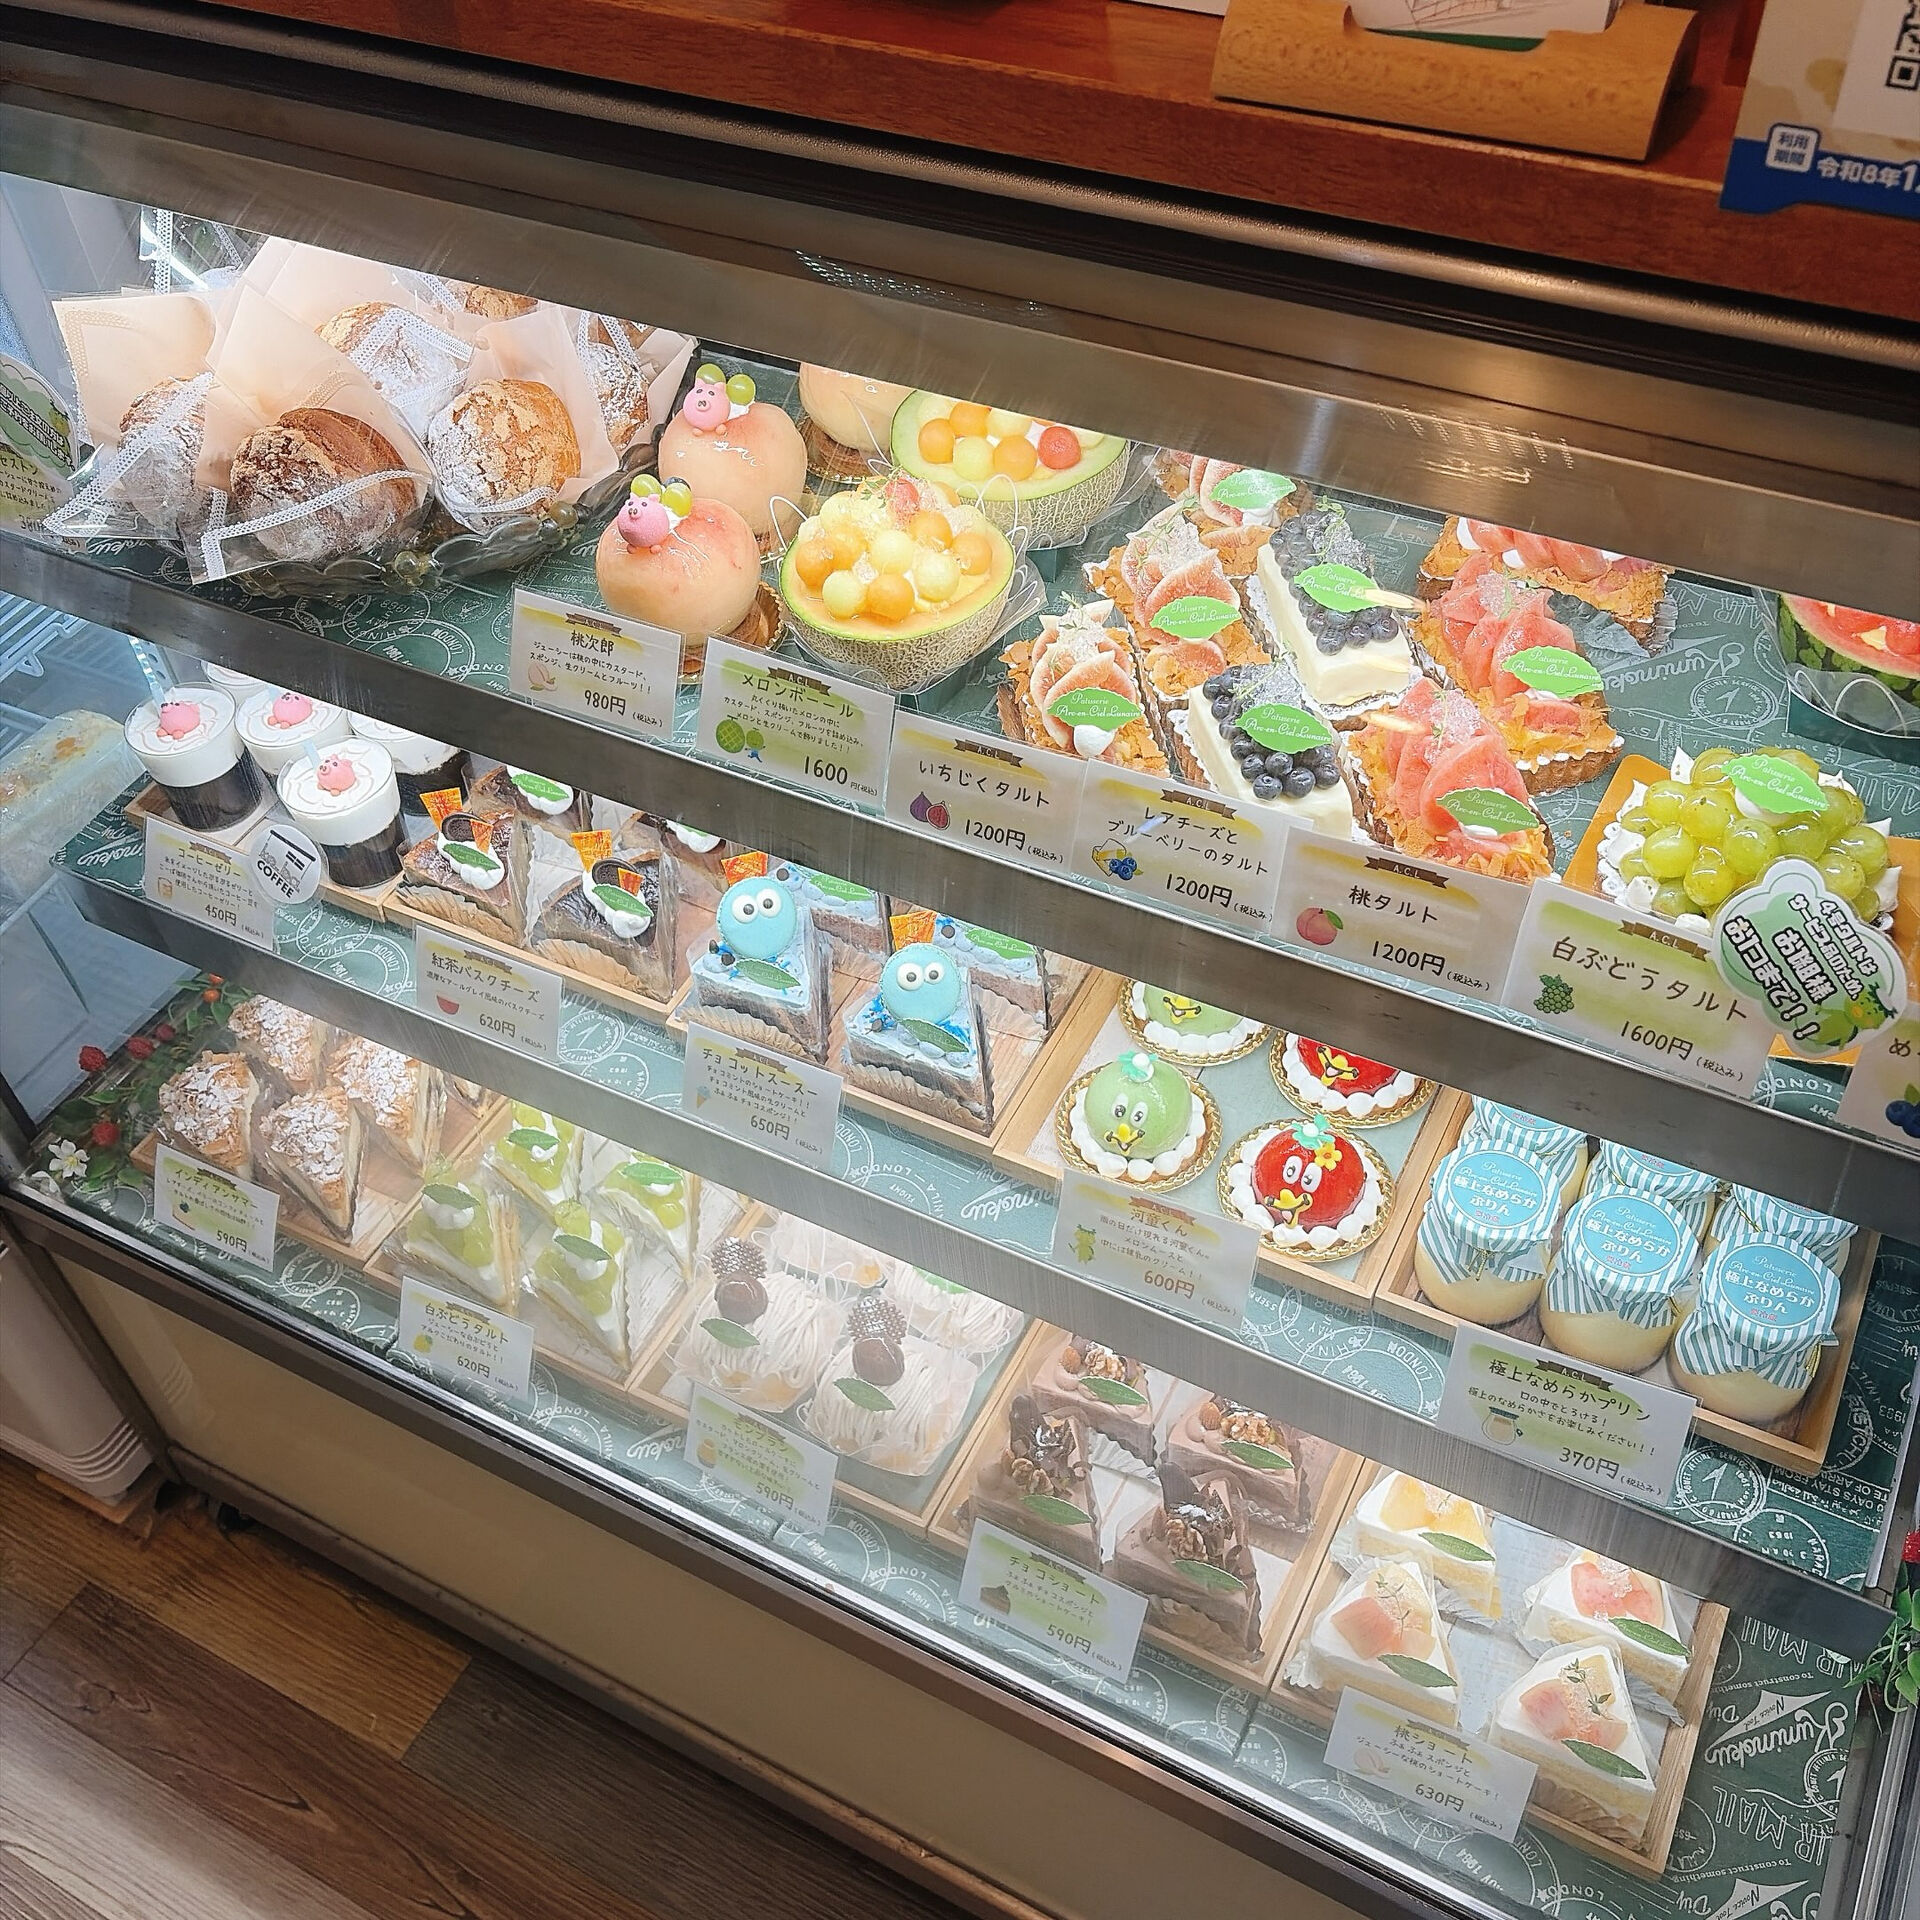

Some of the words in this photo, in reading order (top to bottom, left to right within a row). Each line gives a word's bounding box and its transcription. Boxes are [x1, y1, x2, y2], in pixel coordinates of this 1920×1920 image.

[1779, 132, 1810, 149] 利用
[570, 630, 614, 657] 桃次郎
[584, 689, 626, 716] 980円
[751, 694, 840, 728] 丸くくり抜いたメロンの中に
[804, 756, 848, 785] 1600
[920, 760, 1050, 807] いちじくタルト
[965, 819, 1026, 850] 1200円
[1145, 807, 1238, 845] レアチーズと
[178, 848, 241, 877] コーヒーゼリー
[1108, 819, 1269, 876] ブルーベリーのタルト
[257, 860, 294, 899] COFFEE
[1166, 873, 1232, 908] 1200円
[204, 904, 237, 926] 450円
[1348, 885, 1439, 924] 桃タルト
[1787, 894, 1864, 1001] サービス品のため、
[1819, 900, 1879, 976] 4号タルトは
[1372, 941, 1446, 977] 1200円
[431, 952, 541, 1003] 紅茶バスクチーズ
[1552, 935, 1748, 1022] 白ぶどうタルト
[479, 1013, 516, 1038] 620円
[1620, 1021, 1693, 1061] 1600円
[702, 1048, 818, 1096] チョコットスースー
[751, 1114, 790, 1140] 650円
[175, 1169, 258, 1209] インディアンサマー
[1454, 1176, 1537, 1209] 極上なめらか
[1469, 1195, 1510, 1216] ぷりん
[1130, 1210, 1188, 1237] 河童くん
[1586, 1219, 1670, 1257] 極上なめらか
[216, 1230, 248, 1252] 590円
[1124, 1237, 1184, 1263] メロンムースと
[1601, 1240, 1643, 1263] ぷりん
[1144, 1270, 1195, 1300] 600円
[1725, 1270, 1815, 1308] 極上なめらか
[1743, 1292, 1788, 1314] ぷりん
[425, 1303, 509, 1345] 白ぶどうタルト
[457, 1356, 490, 1378] 620円
[1488, 1359, 1651, 1422] 極上なめらかプリン
[1467, 1386, 1655, 1456] 極上のなめらかさをお楽しみください！！
[1520, 1390, 1607, 1427] 口の中でとろける！
[734, 1421, 790, 1452] モンブラン
[1559, 1447, 1620, 1480] 370円
[756, 1482, 794, 1511] 590円
[1009, 1556, 1100, 1605] チョコショート
[1046, 1624, 1092, 1655] 590円
[1755, 1673, 1800, 1687] construct
[1393, 1725, 1473, 1765] 桃ショート
[1704, 1701, 1848, 1768] Kumimoku
[1415, 1783, 1464, 1813] 630円
[1712, 1785, 1788, 1850] MAIL
[1729, 1859, 1779, 1875] construct
[1779, 1858, 1792, 1867] To
[1676, 1890, 1712, 1916] Diy
